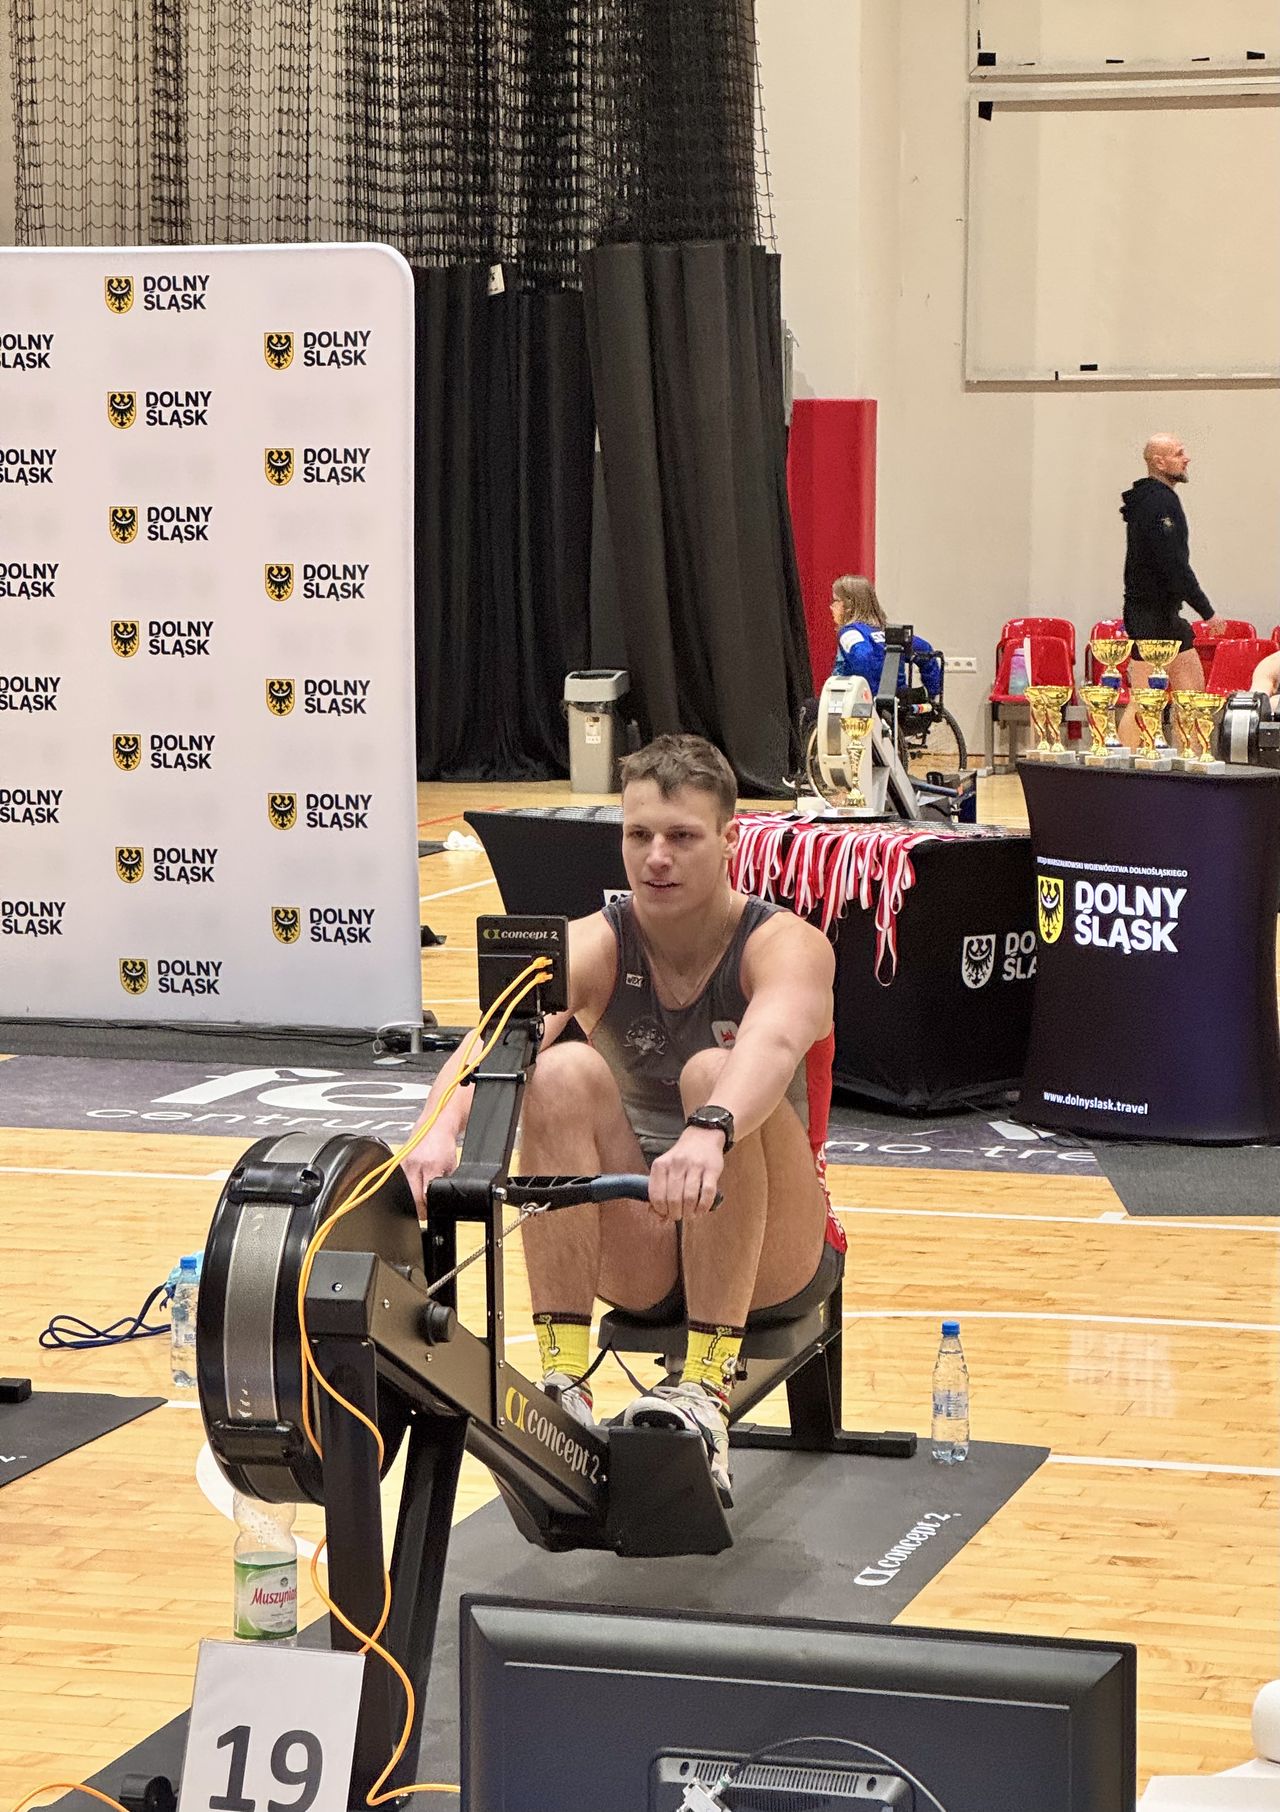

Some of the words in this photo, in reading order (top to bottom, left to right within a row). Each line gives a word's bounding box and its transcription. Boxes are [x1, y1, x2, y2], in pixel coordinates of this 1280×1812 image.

[144, 275, 209, 292] DOLNY
[144, 289, 206, 312] ŚLĄSK
[0, 334, 53, 350] OLNY
[304, 331, 371, 348] DOLNY
[0, 349, 50, 371] LĄSK
[304, 345, 366, 368] ŚLĄSK
[146, 391, 211, 408] DOLNY
[146, 405, 207, 428] ŚLĄSK
[304, 448, 370, 465] DOLNY
[304, 463, 365, 485] ŚLĄSK
[148, 507, 212, 524] DOLNY
[148, 522, 208, 543] ŚLĄSK
[304, 564, 369, 581] DOLNY
[303, 580, 364, 601] ŚLĄSK
[149, 621, 213, 638] DOLNY
[149, 636, 209, 658] ŚLĄSK
[0, 677, 60, 693] DOLNY
[305, 680, 370, 696] DOLNY
[0, 691, 56, 713] ŚLĄSK
[305, 694, 366, 716] ŚLĄSK
[151, 735, 215, 751] DOLNY
[151, 750, 211, 771] ŚLĄSK
[0, 789, 62, 806] DOLNY
[307, 794, 372, 811] DOLNY
[0, 804, 59, 825] ŚLĄSK
[307, 809, 367, 831] ŚLĄSK
[154, 848, 217, 864] DOLNY
[154, 862, 214, 884] ŚLĄSK
[1129, 866, 1188, 878] DOLNOŚLĄSKIEGO
[2, 901, 65, 918] DOLNY
[1075, 880, 1188, 919] DOLNY
[2, 916, 62, 937] ŚLĄSK
[310, 908, 374, 925] DOLNY
[311, 923, 371, 945] ŚLĄSK
[500, 930, 548, 941] concept
[550, 931, 559, 941] 2
[1074, 907, 1179, 954] ŚLĄSK
[1005, 930, 1037, 955] DO
[158, 960, 222, 977] DOLNY
[159, 974, 219, 996] ŚLĄSK
[1044, 1091, 1148, 1115] www.dolnyslask.travel
[528, 1409, 590, 1476] concept
[589, 1455, 600, 1484] 2
[878, 1521, 941, 1568] concept
[209, 1725, 323, 1812] 19
